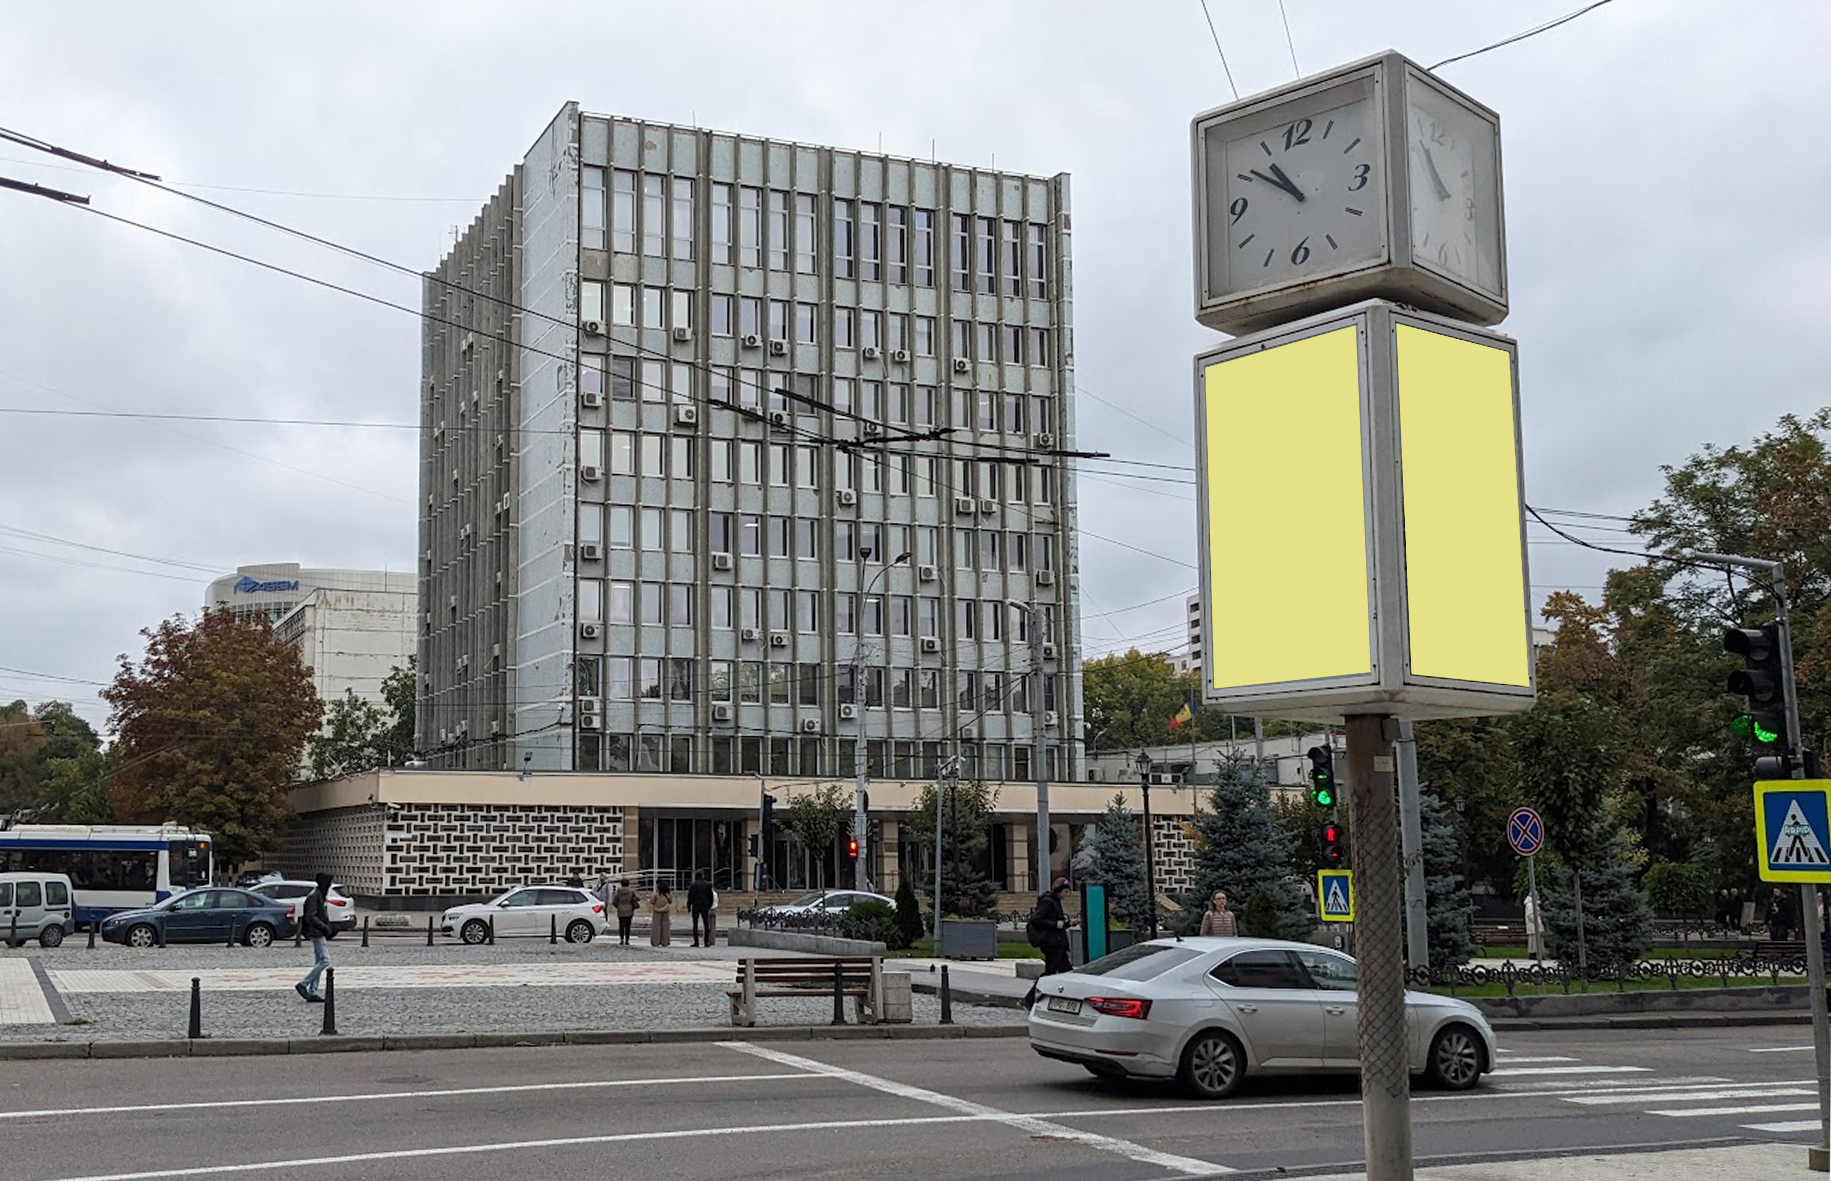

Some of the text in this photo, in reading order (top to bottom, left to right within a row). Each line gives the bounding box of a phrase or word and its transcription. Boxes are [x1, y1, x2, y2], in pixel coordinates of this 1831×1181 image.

[1282, 118, 1313, 151] 12
[1348, 163, 1371, 192] 3
[1230, 197, 1248, 226] 9
[1291, 235, 1310, 265] 6
